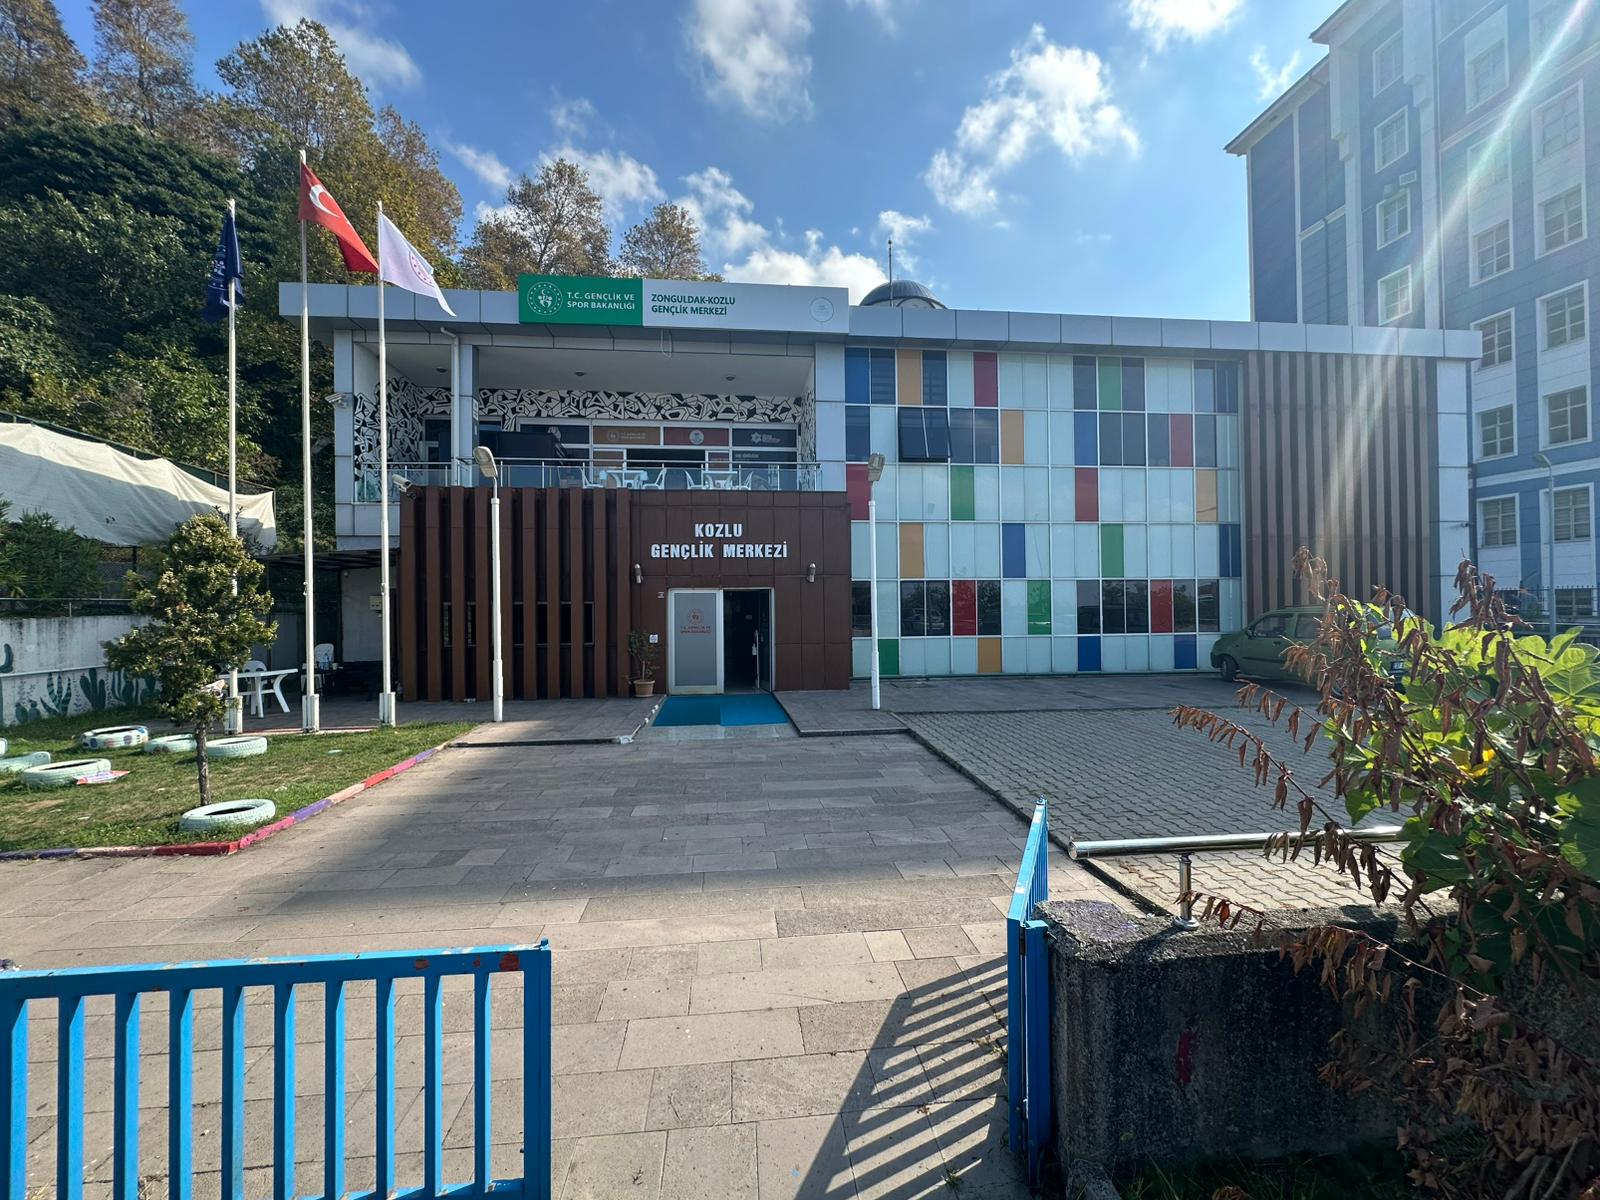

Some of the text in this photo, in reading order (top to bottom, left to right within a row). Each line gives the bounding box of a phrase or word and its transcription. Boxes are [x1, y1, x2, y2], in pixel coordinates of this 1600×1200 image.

[584, 292, 621, 301] GENÇLİK
[624, 293, 635, 301] VE
[651, 294, 735, 305] ZONGULDAK-KOZLU
[651, 305, 727, 315] GENÇLİK MERKEZİ
[694, 523, 743, 538] KOZLU
[651, 541, 788, 560] GENÇLİK MERKEZİ
